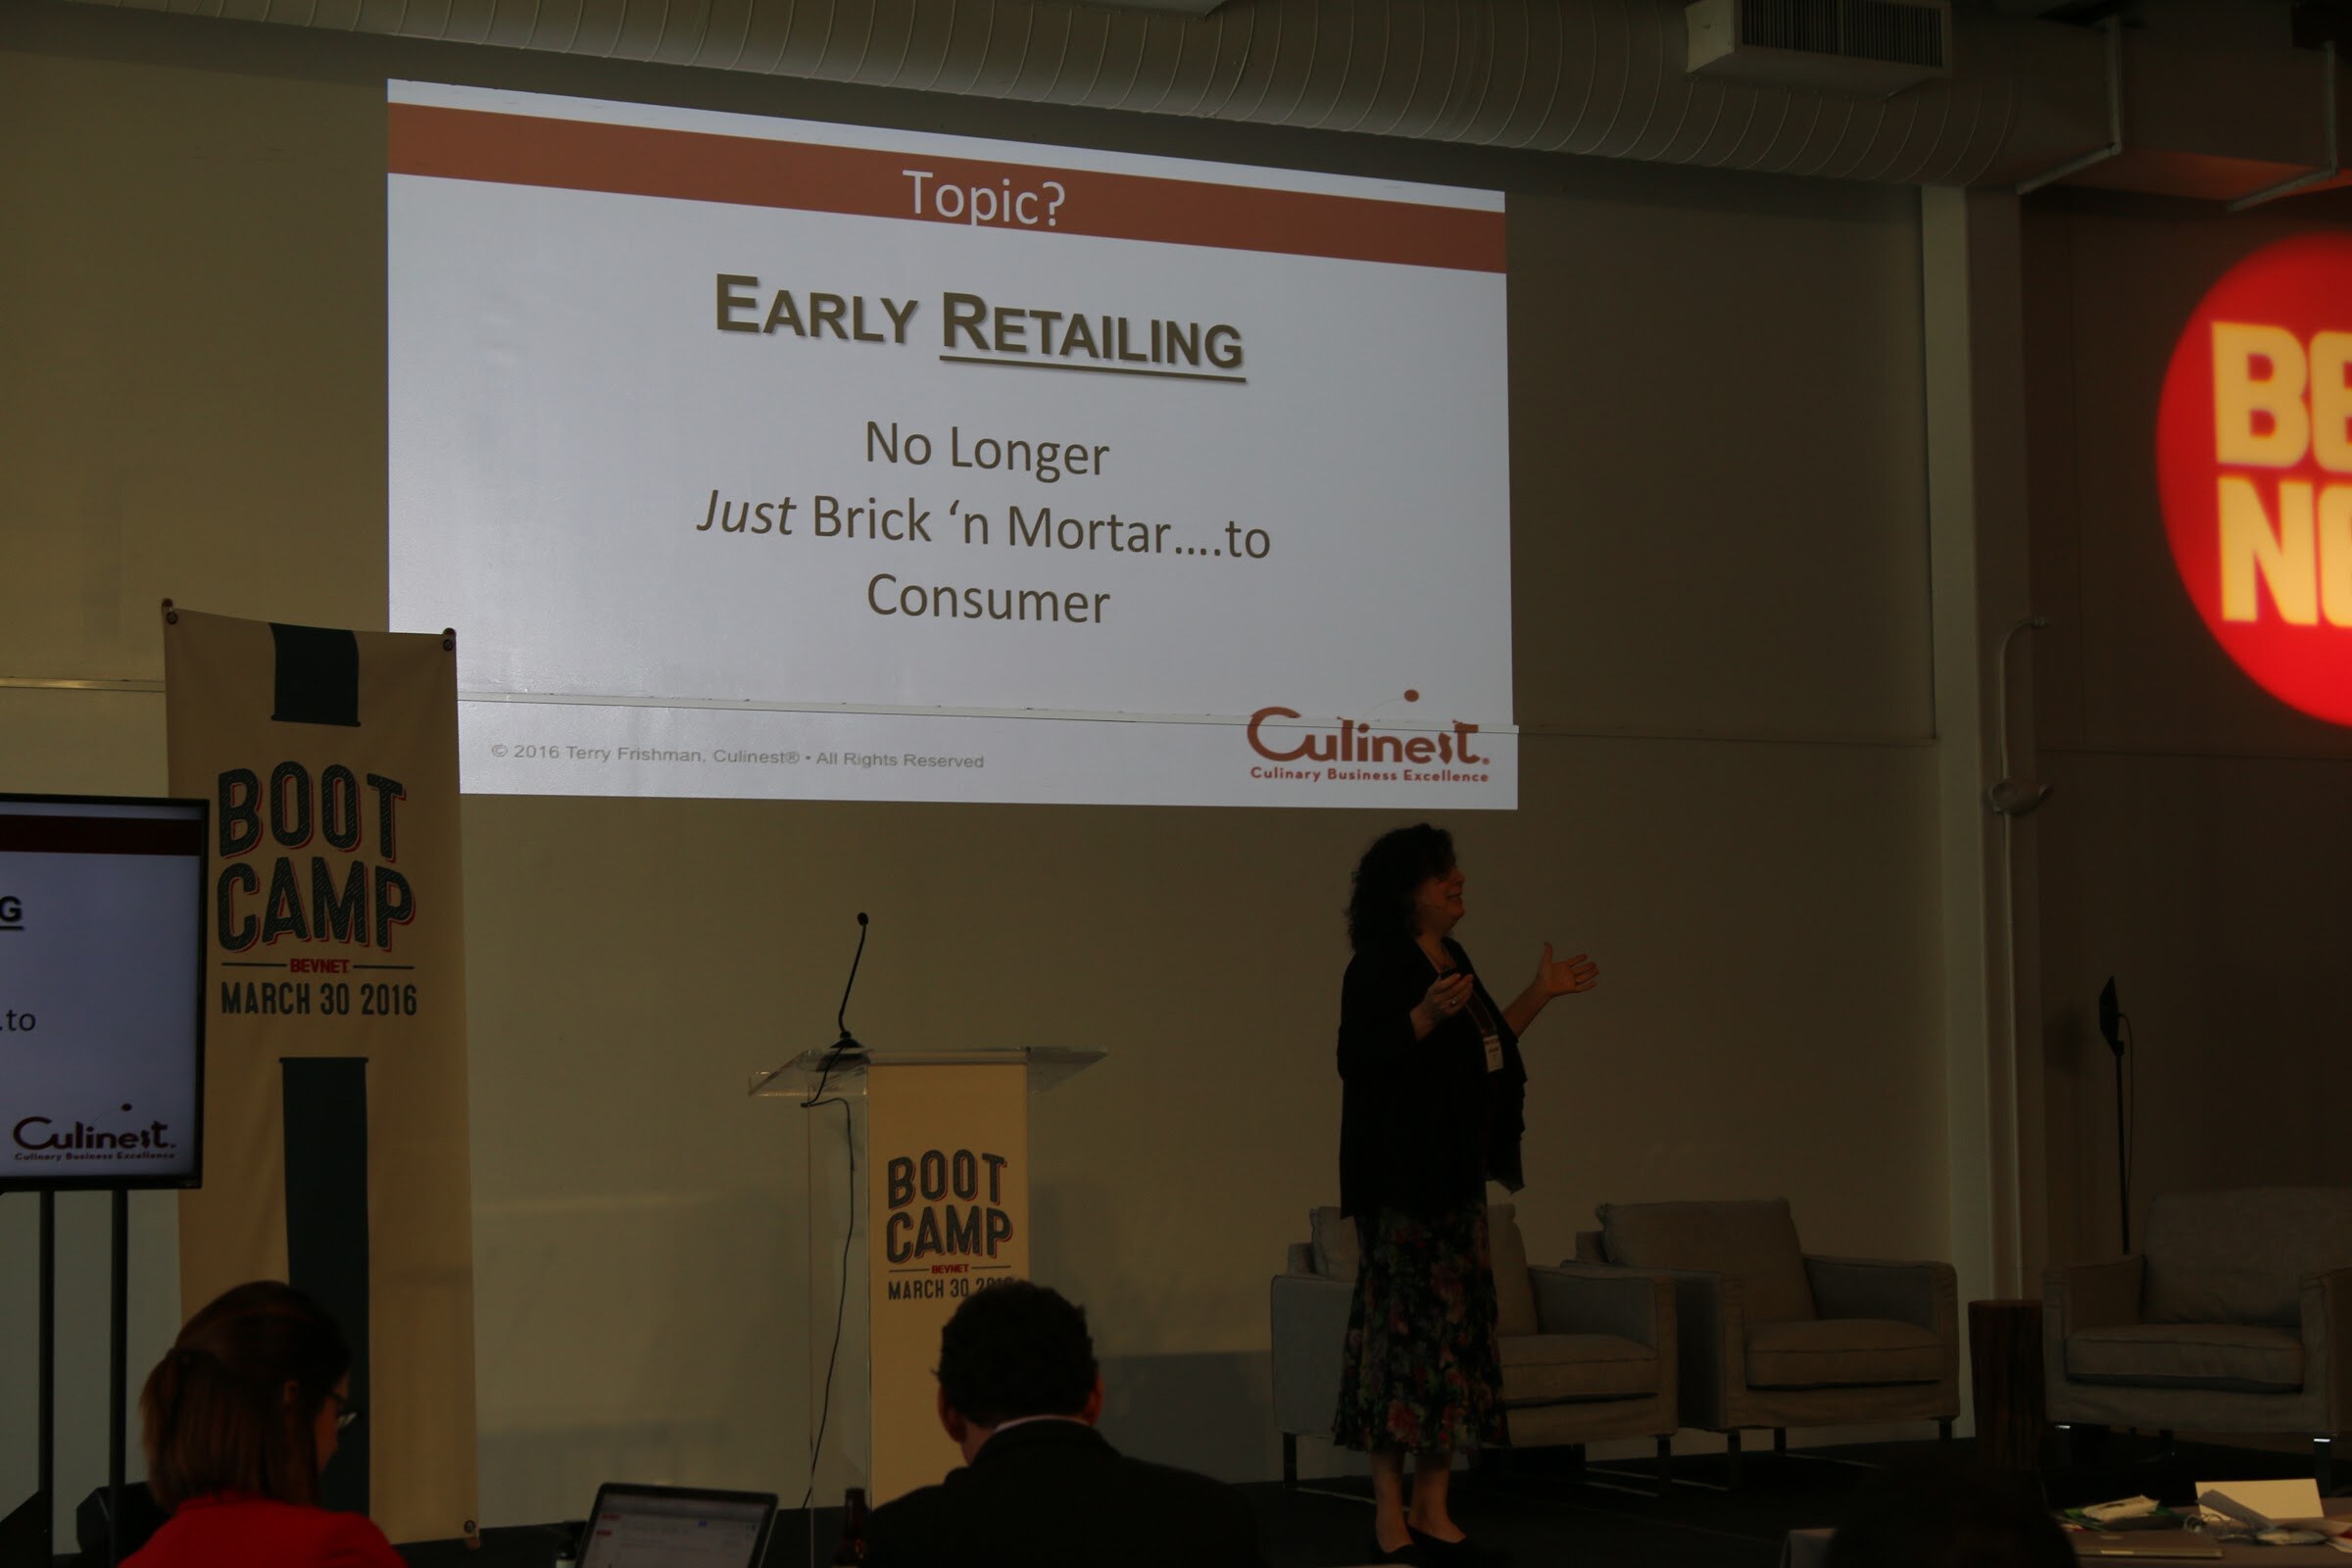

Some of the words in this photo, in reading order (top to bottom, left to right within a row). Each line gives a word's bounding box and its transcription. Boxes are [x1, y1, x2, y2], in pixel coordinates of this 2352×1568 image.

[903, 169, 1066, 227] Topic?
[715, 273, 919, 344] EARLY
[941, 291, 1245, 372] RETAILING
[866, 420, 932, 466] No
[951, 426, 1110, 483] Longer
[696, 489, 797, 536] Just
[814, 495, 932, 543] Brick
[867, 573, 1110, 624] Consumer
[514, 744, 560, 760] 2016
[565, 745, 612, 763] Terry
[617, 747, 707, 764] Frishman,
[816, 751, 838, 765] All
[844, 752, 899, 769] Rights
[904, 753, 985, 768] Reserved
[1250, 766, 1321, 783] Culinary
[1327, 768, 1397, 782] Business
[1403, 769, 1490, 783] Excellence
[219, 760, 407, 862] BOOT
[218, 857, 416, 954] CAMP
[290, 958, 351, 973] BEVNET
[221, 981, 311, 1015] MARCH
[319, 982, 350, 1015] 30
[360, 983, 417, 1016] 2016
[888, 1149, 1007, 1210] BOOT
[886, 1204, 1012, 1264] CAMP
[888, 1279, 945, 1300] MARCH
[951, 1278, 970, 1298] 30
[931, 1263, 970, 1274] BEVNET
